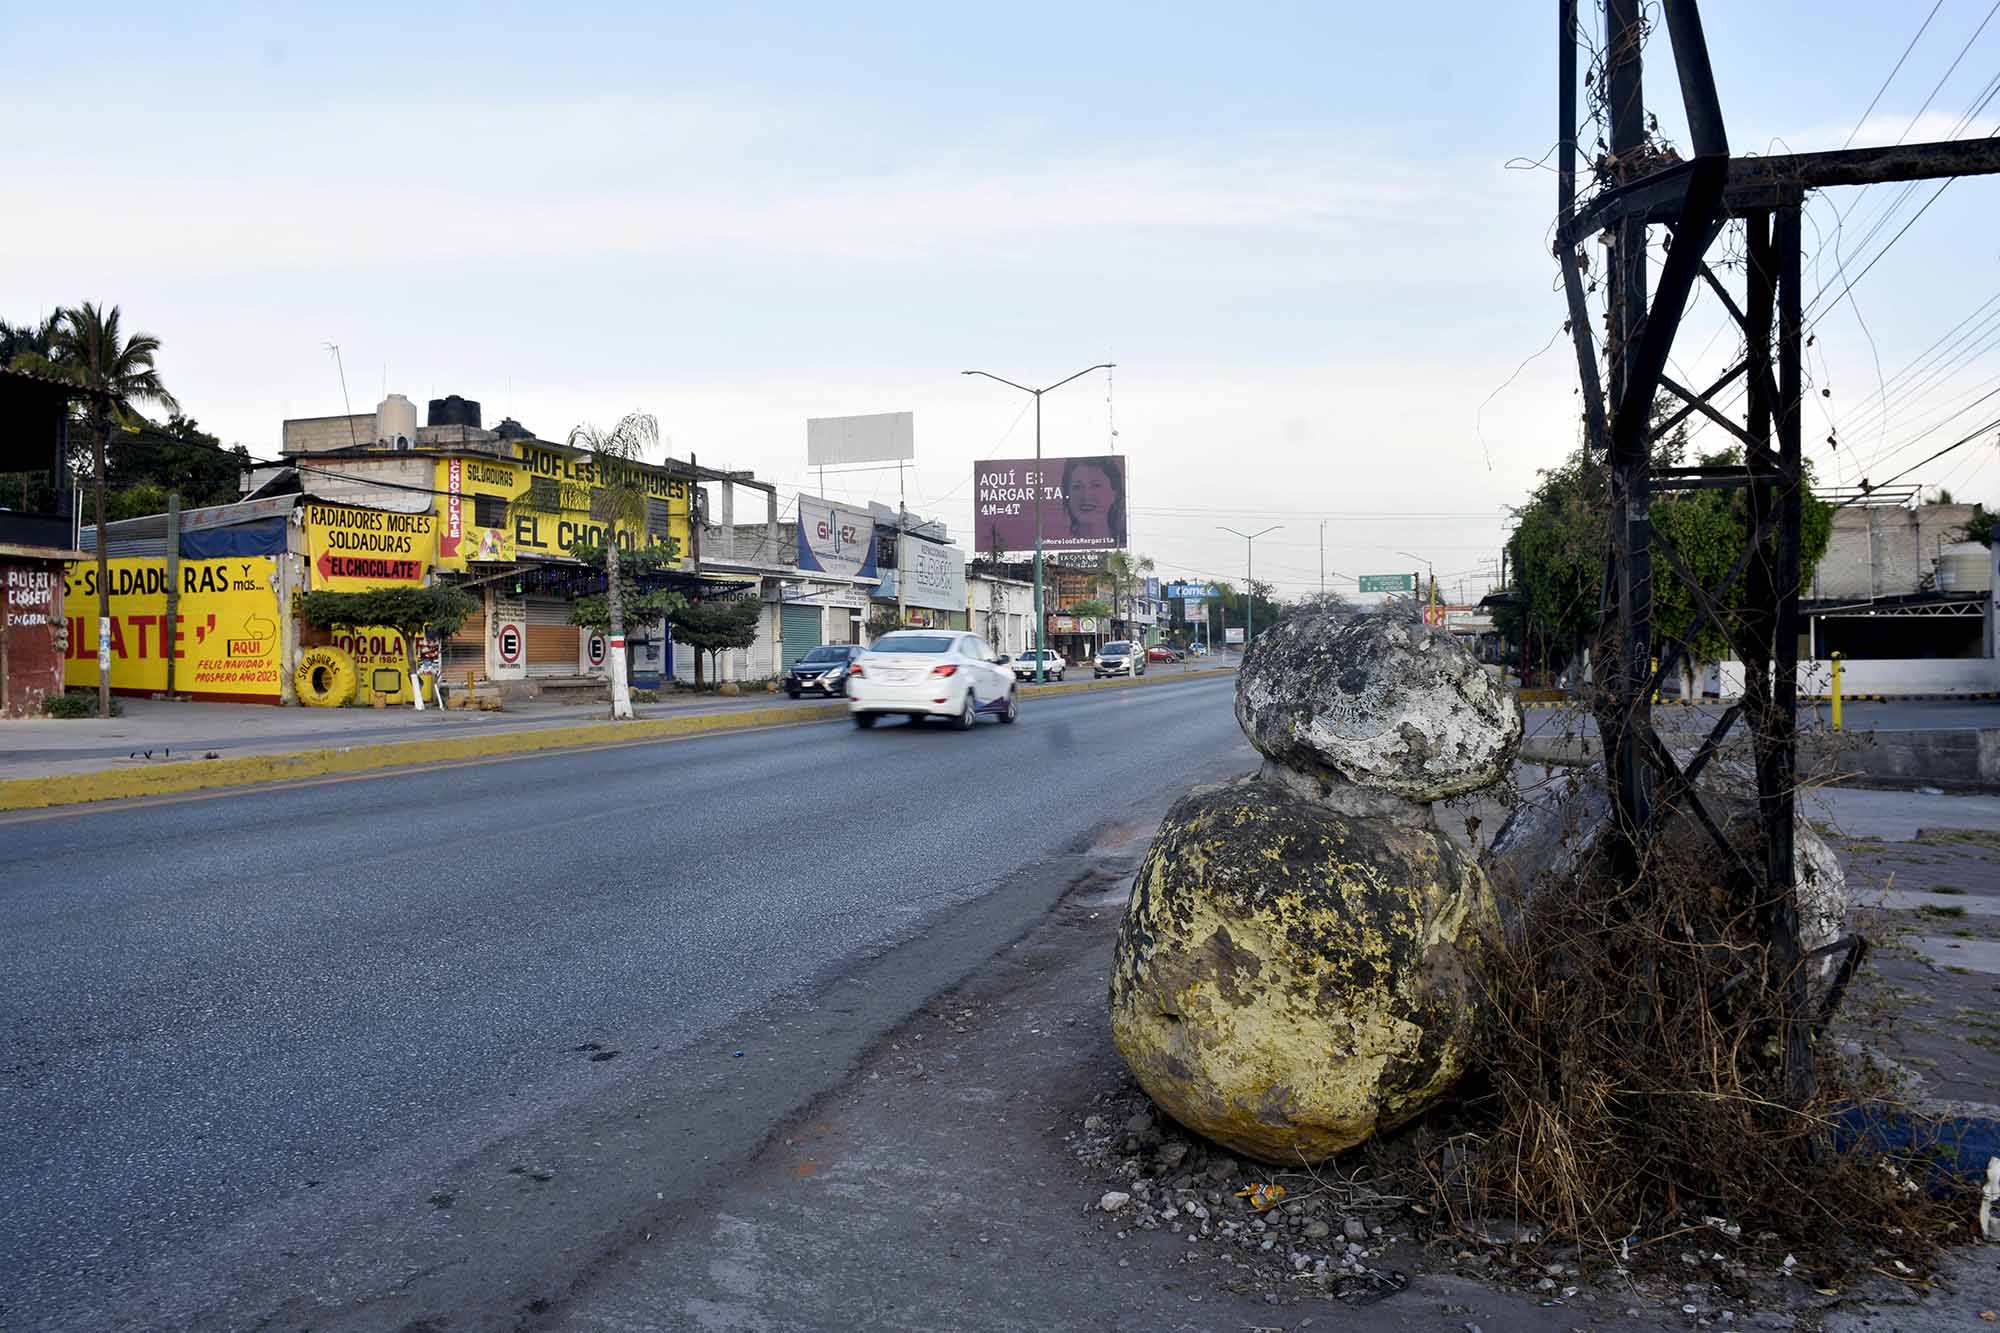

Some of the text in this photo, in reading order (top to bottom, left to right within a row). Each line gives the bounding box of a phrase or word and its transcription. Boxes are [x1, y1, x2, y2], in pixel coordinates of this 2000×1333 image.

[980, 469, 1016, 488] AQUÍ
[980, 487, 1070, 502] MARGARTA.
[980, 504, 1020, 516] 4M=4T
[311, 506, 431, 534] RADIADORES MOFLES
[515, 514, 548, 549] EL
[328, 530, 412, 553] SOLDADURAS
[241, 564, 252, 578] Y
[232, 641, 261, 654] AQUI
[504, 634, 517, 654] E
[592, 639, 602, 658] E
[198, 660, 223, 670] FELIZ
[223, 659, 264, 670] NAVIDAD
[256, 670, 278, 682] 2023
